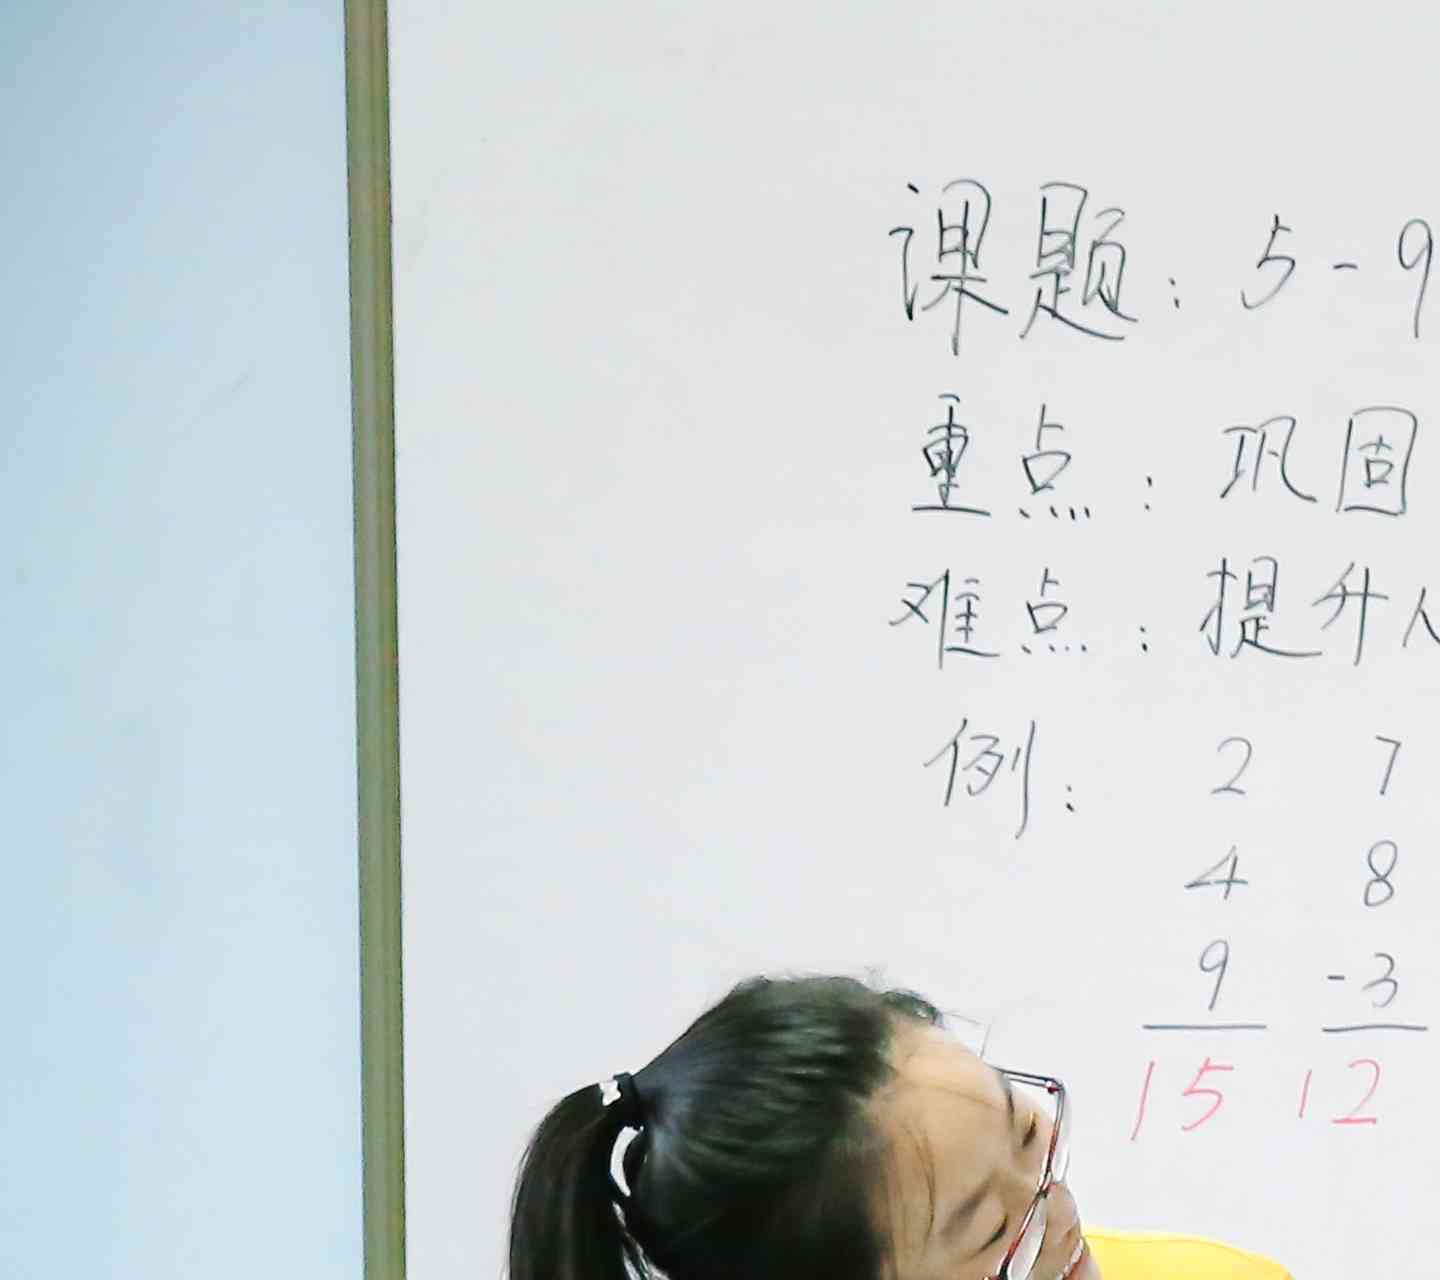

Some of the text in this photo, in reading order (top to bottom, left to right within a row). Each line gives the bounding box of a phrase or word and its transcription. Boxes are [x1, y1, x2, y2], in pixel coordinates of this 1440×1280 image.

[1211, 737, 1252, 797] 2
[1376, 735, 1402, 796] 7
[1184, 846, 1248, 900] 4
[1364, 840, 1397, 907] 8
[1199, 940, 1229, 1011] 9
[1131, 1057, 1234, 1140] 15
[1299, 1059, 1380, 1124] 12
